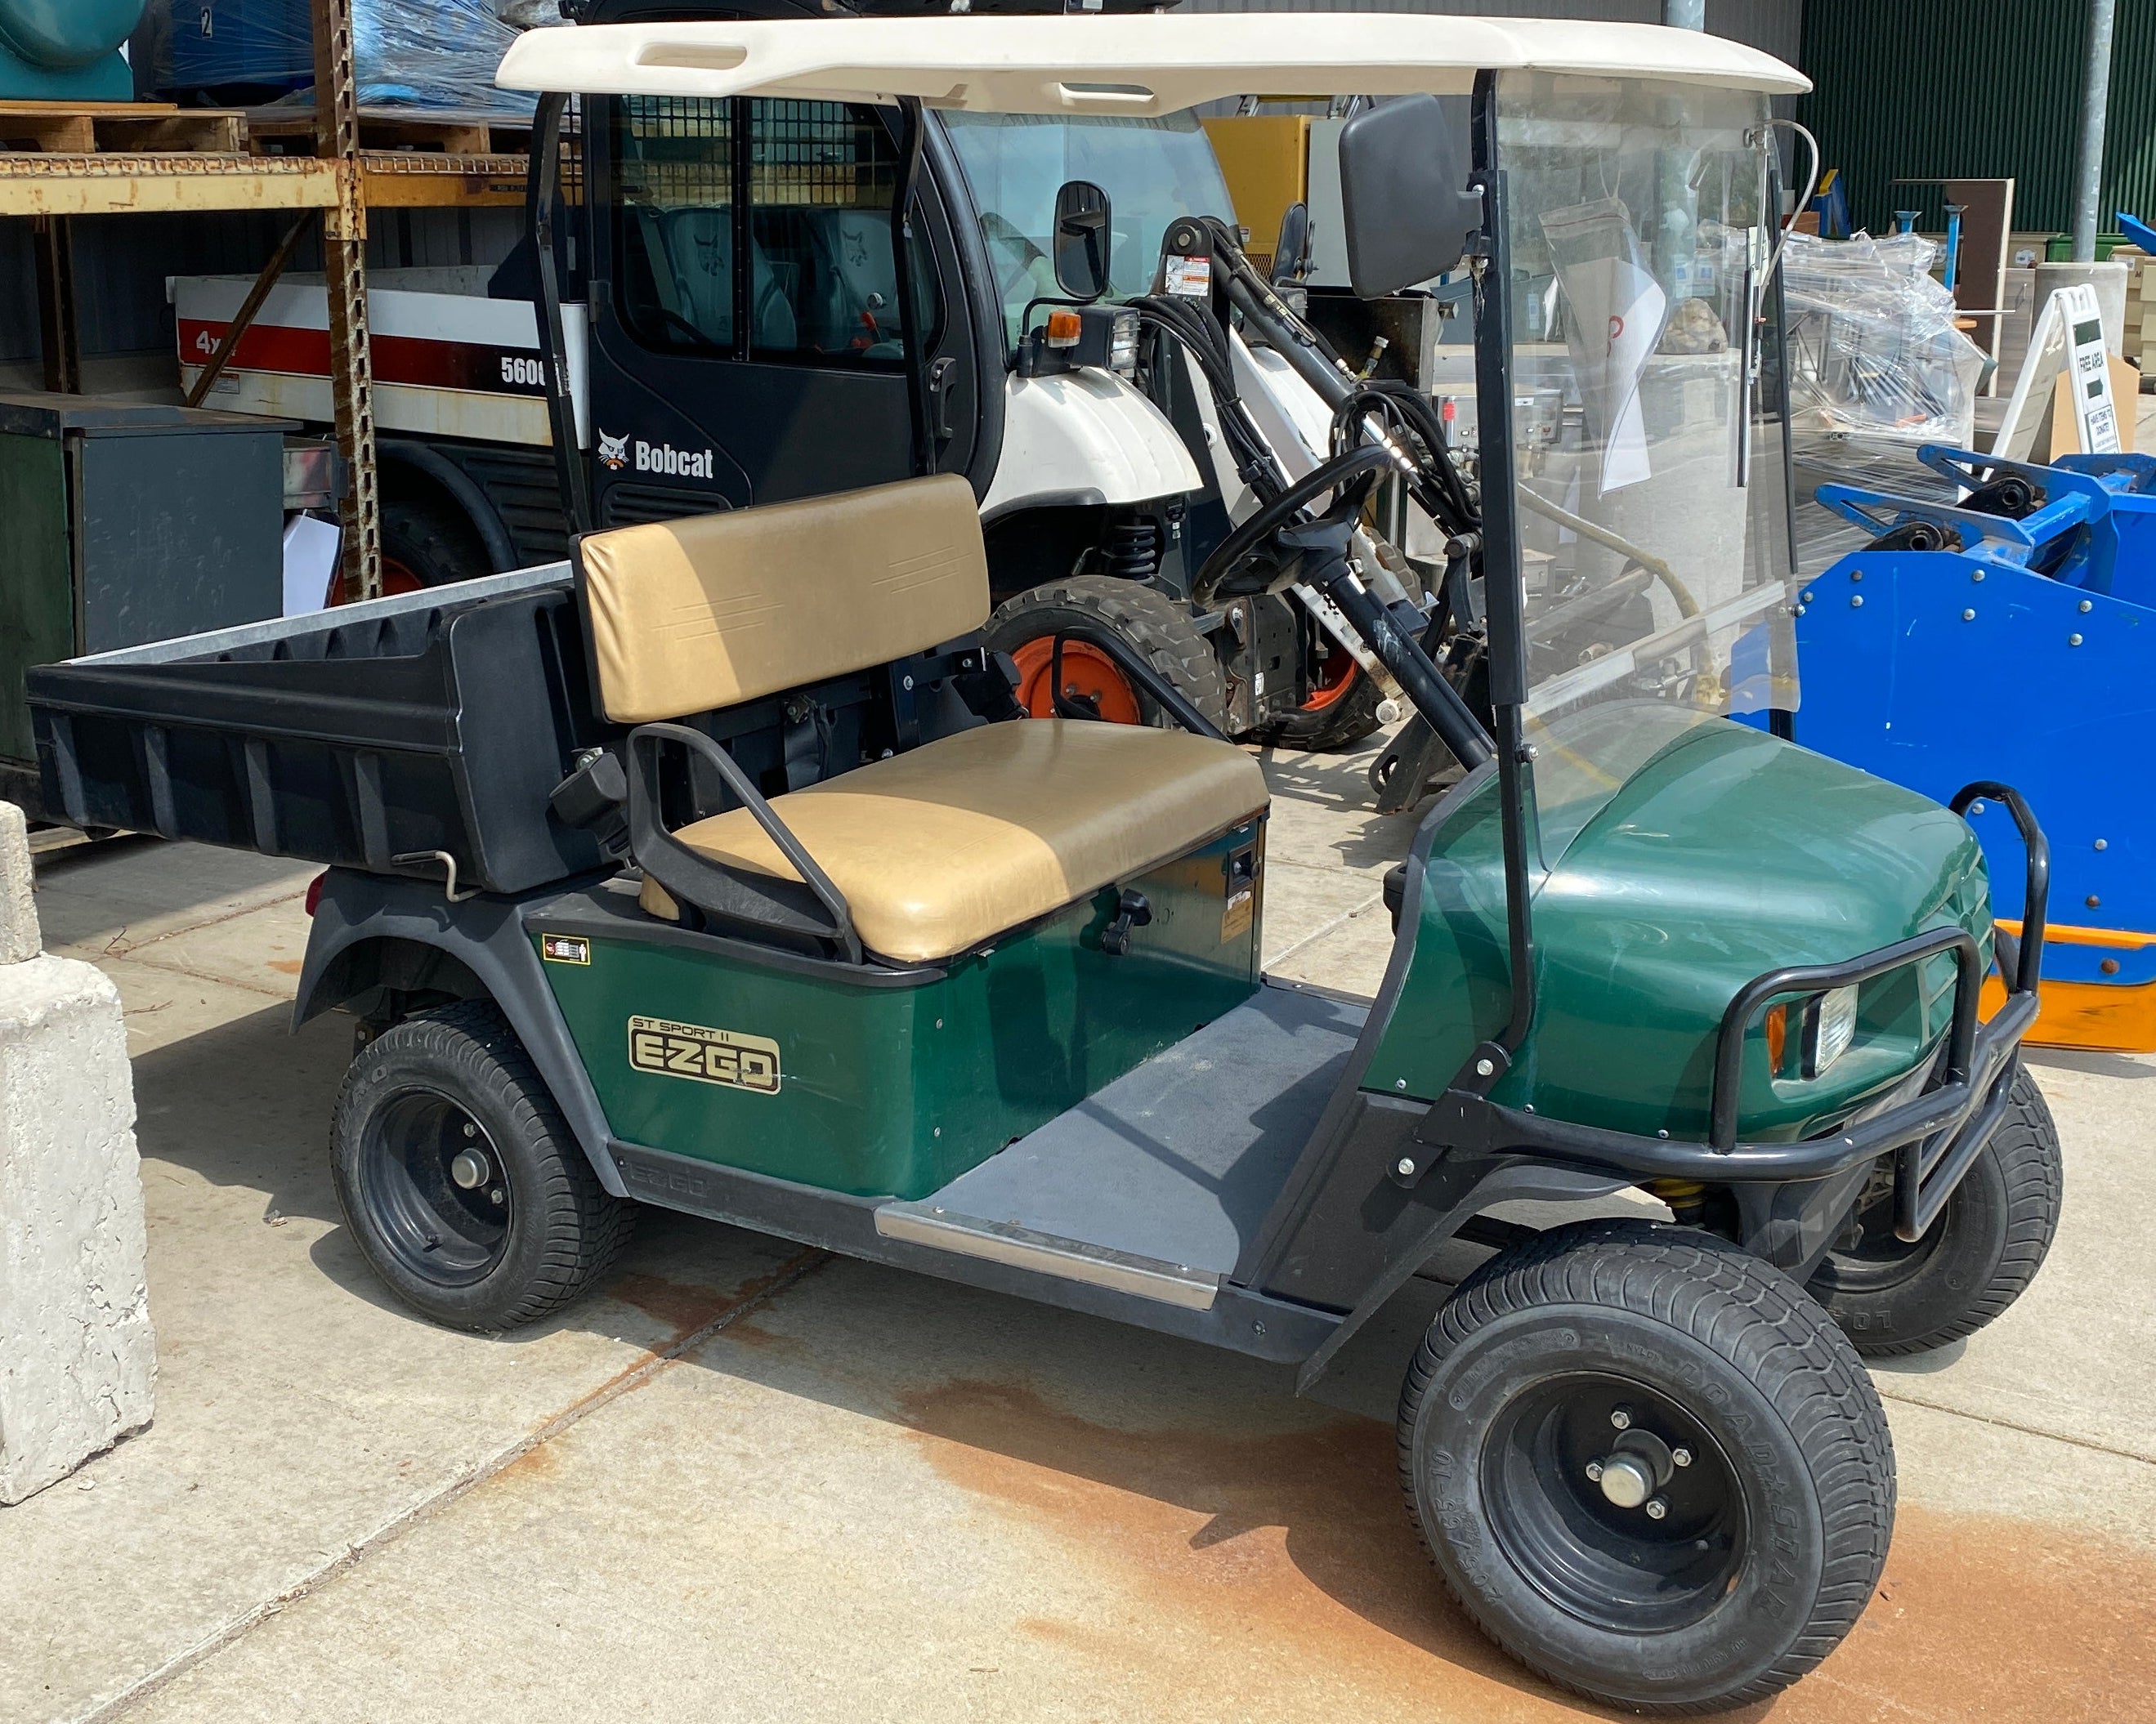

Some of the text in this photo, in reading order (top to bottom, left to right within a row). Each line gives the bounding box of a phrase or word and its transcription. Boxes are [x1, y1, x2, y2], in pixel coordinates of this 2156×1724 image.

[202, 8, 211, 38] 2
[196, 330, 237, 357] 4x
[2079, 355, 2092, 373] FREE
[635, 440, 713, 479] Bobcat
[633, 1017, 729, 1043] ST SPORT II
[634, 1032, 774, 1088] EZGO
[628, 1160, 707, 1199] EZGO
